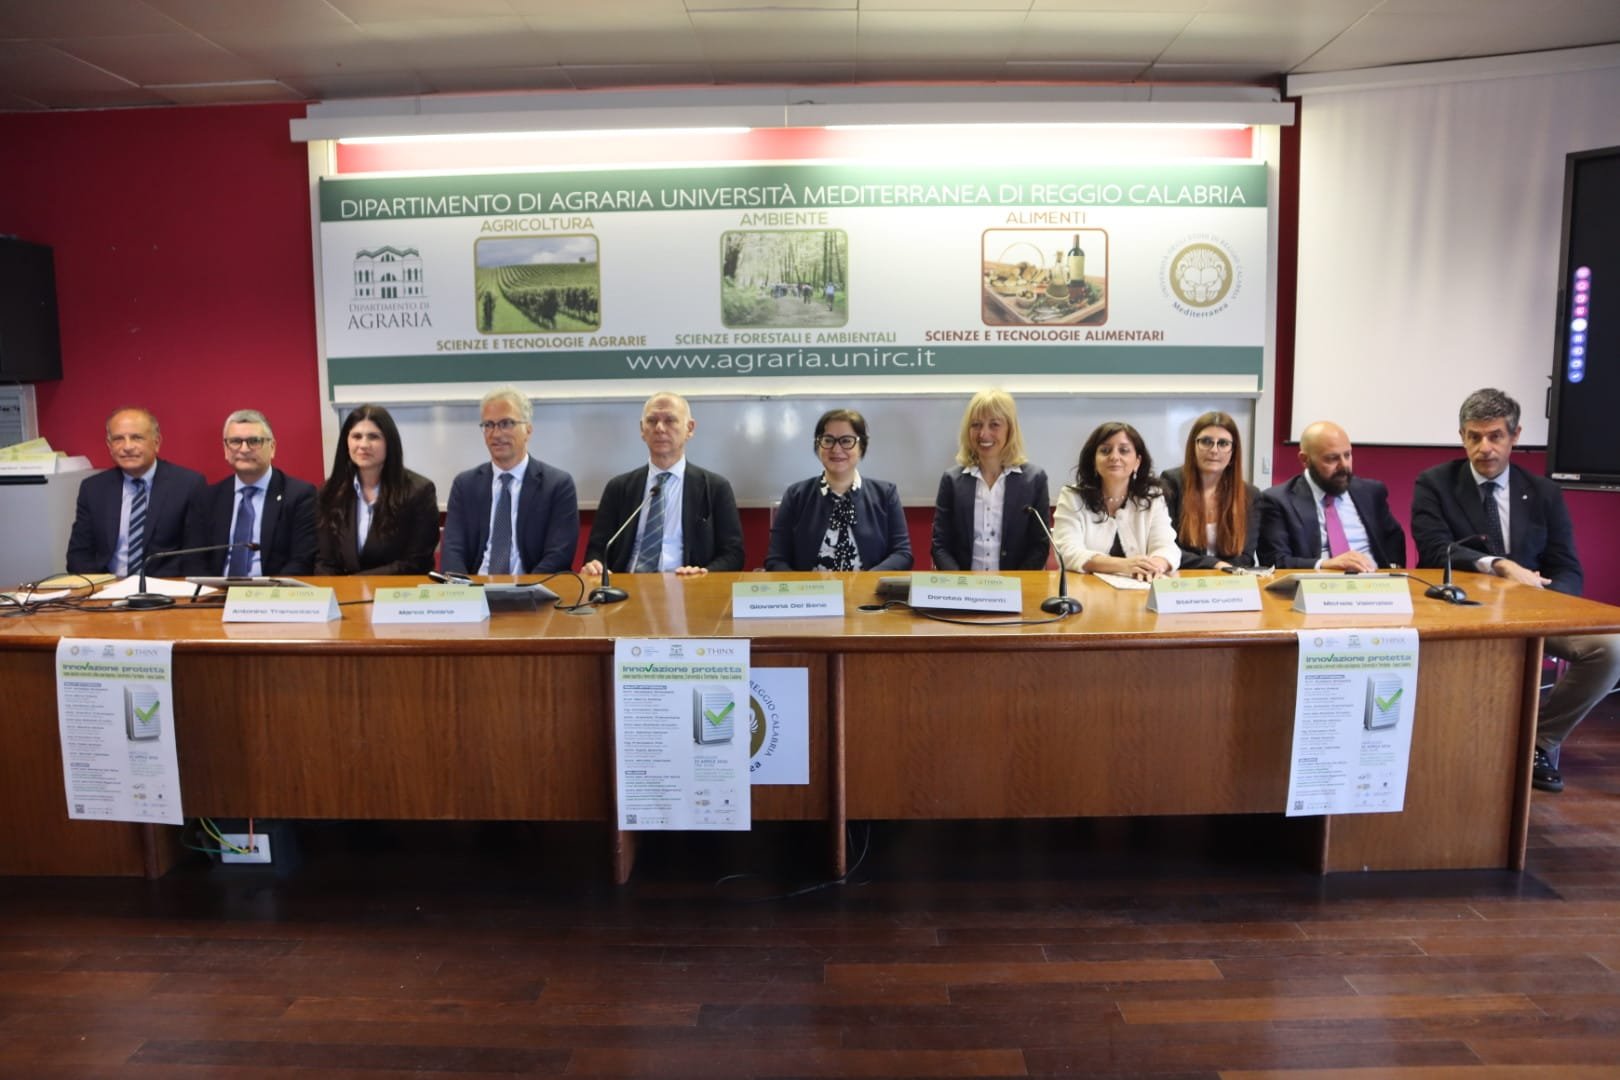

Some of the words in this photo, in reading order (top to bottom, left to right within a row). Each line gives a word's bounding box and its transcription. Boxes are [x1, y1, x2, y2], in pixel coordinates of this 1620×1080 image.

[340, 192, 511, 218] DIPARTIMENTO
[518, 193, 542, 212] DI
[549, 189, 653, 211] AGRARIA
[661, 183, 796, 209] UNIVERSITÀ
[804, 185, 992, 205] MEDITERRANEA
[999, 185, 1023, 204] DI
[1031, 184, 1122, 204] REGGIO
[1127, 185, 1246, 204] CALABRIA
[480, 217, 594, 233] AGRICOLTURA
[740, 211, 828, 227] AMBIENTE
[1006, 211, 1086, 225] ALIMENTI
[349, 302, 417, 312] DIPARTIMENTO
[347, 311, 432, 330] AGRARIA
[436, 337, 489, 351] SCIENZE
[493, 338, 500, 350] E
[503, 335, 584, 349] TECNOLOGIE
[588, 334, 647, 348] AGRARIE
[675, 333, 729, 345] SCIENZE
[734, 331, 802, 344] FORESTALI
[805, 332, 811, 343] E
[816, 331, 897, 343] AMBIENTALI
[925, 329, 980, 342] SCIENZE
[984, 330, 992, 341] E
[996, 329, 1081, 342] TECNOLOGIE
[1084, 329, 1165, 341] ALIMENTARI
[626, 348, 936, 374] www.agraria.unirc.it
[691, 666, 742, 674] protetta
